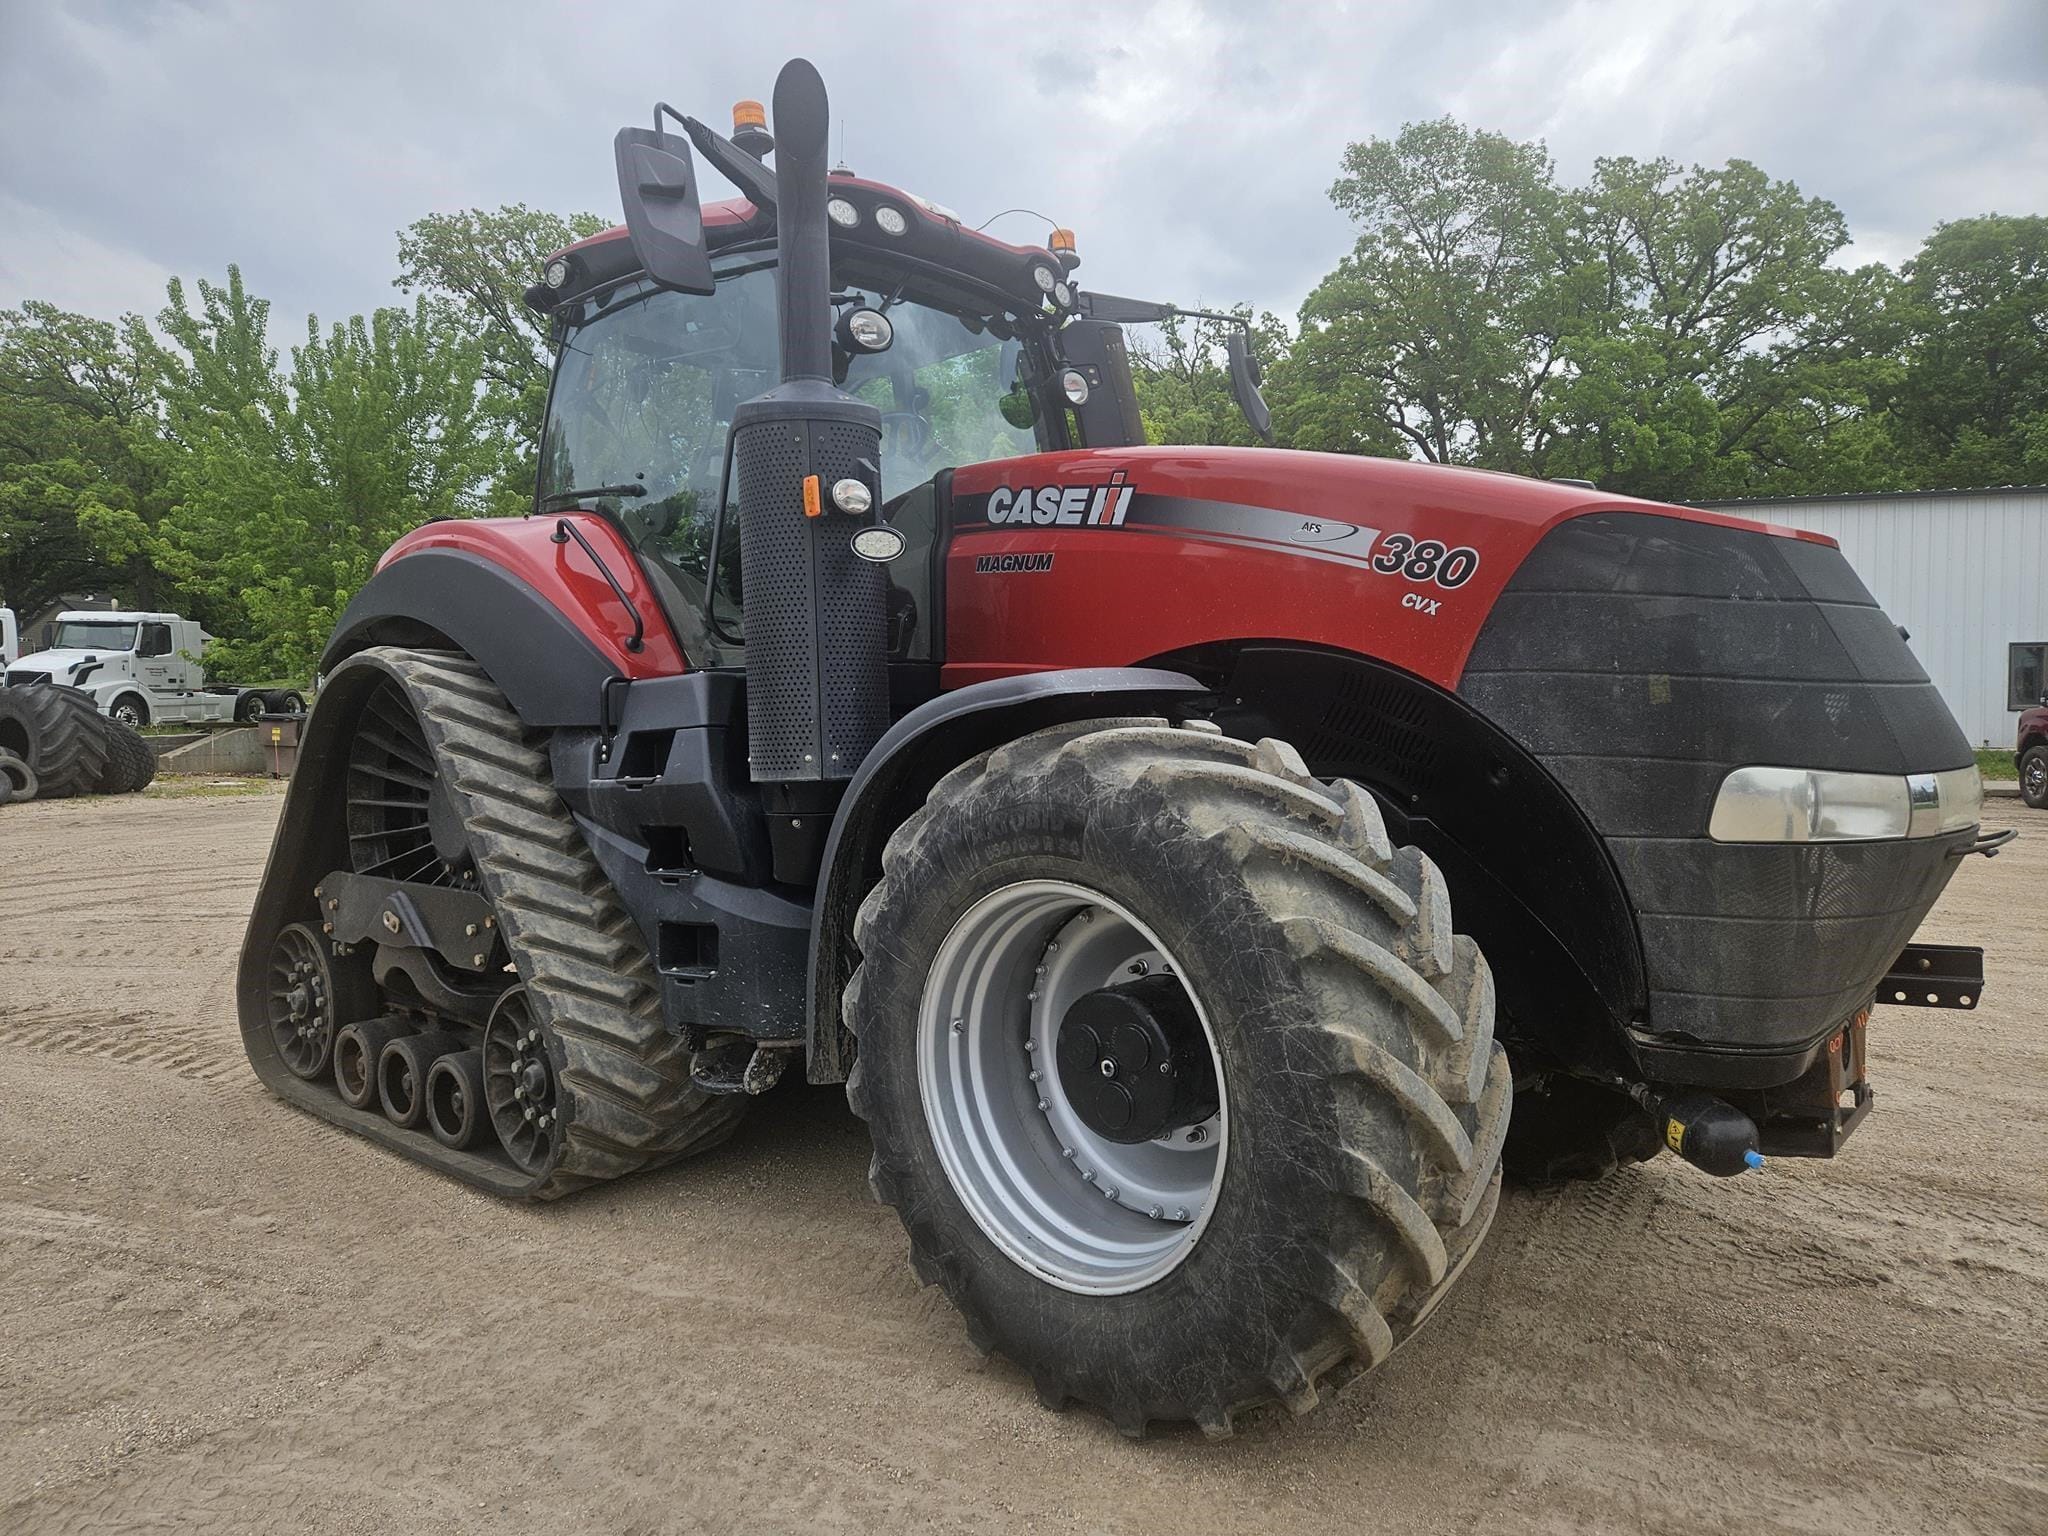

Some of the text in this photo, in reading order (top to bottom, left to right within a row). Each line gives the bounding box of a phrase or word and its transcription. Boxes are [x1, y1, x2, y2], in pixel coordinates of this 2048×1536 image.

[987, 487, 1090, 525] CASE
[1301, 521, 1322, 534] AFS
[976, 552, 1055, 574] MAGNUM
[1372, 533, 1480, 589] 380
[1401, 592, 1442, 616] CVX
